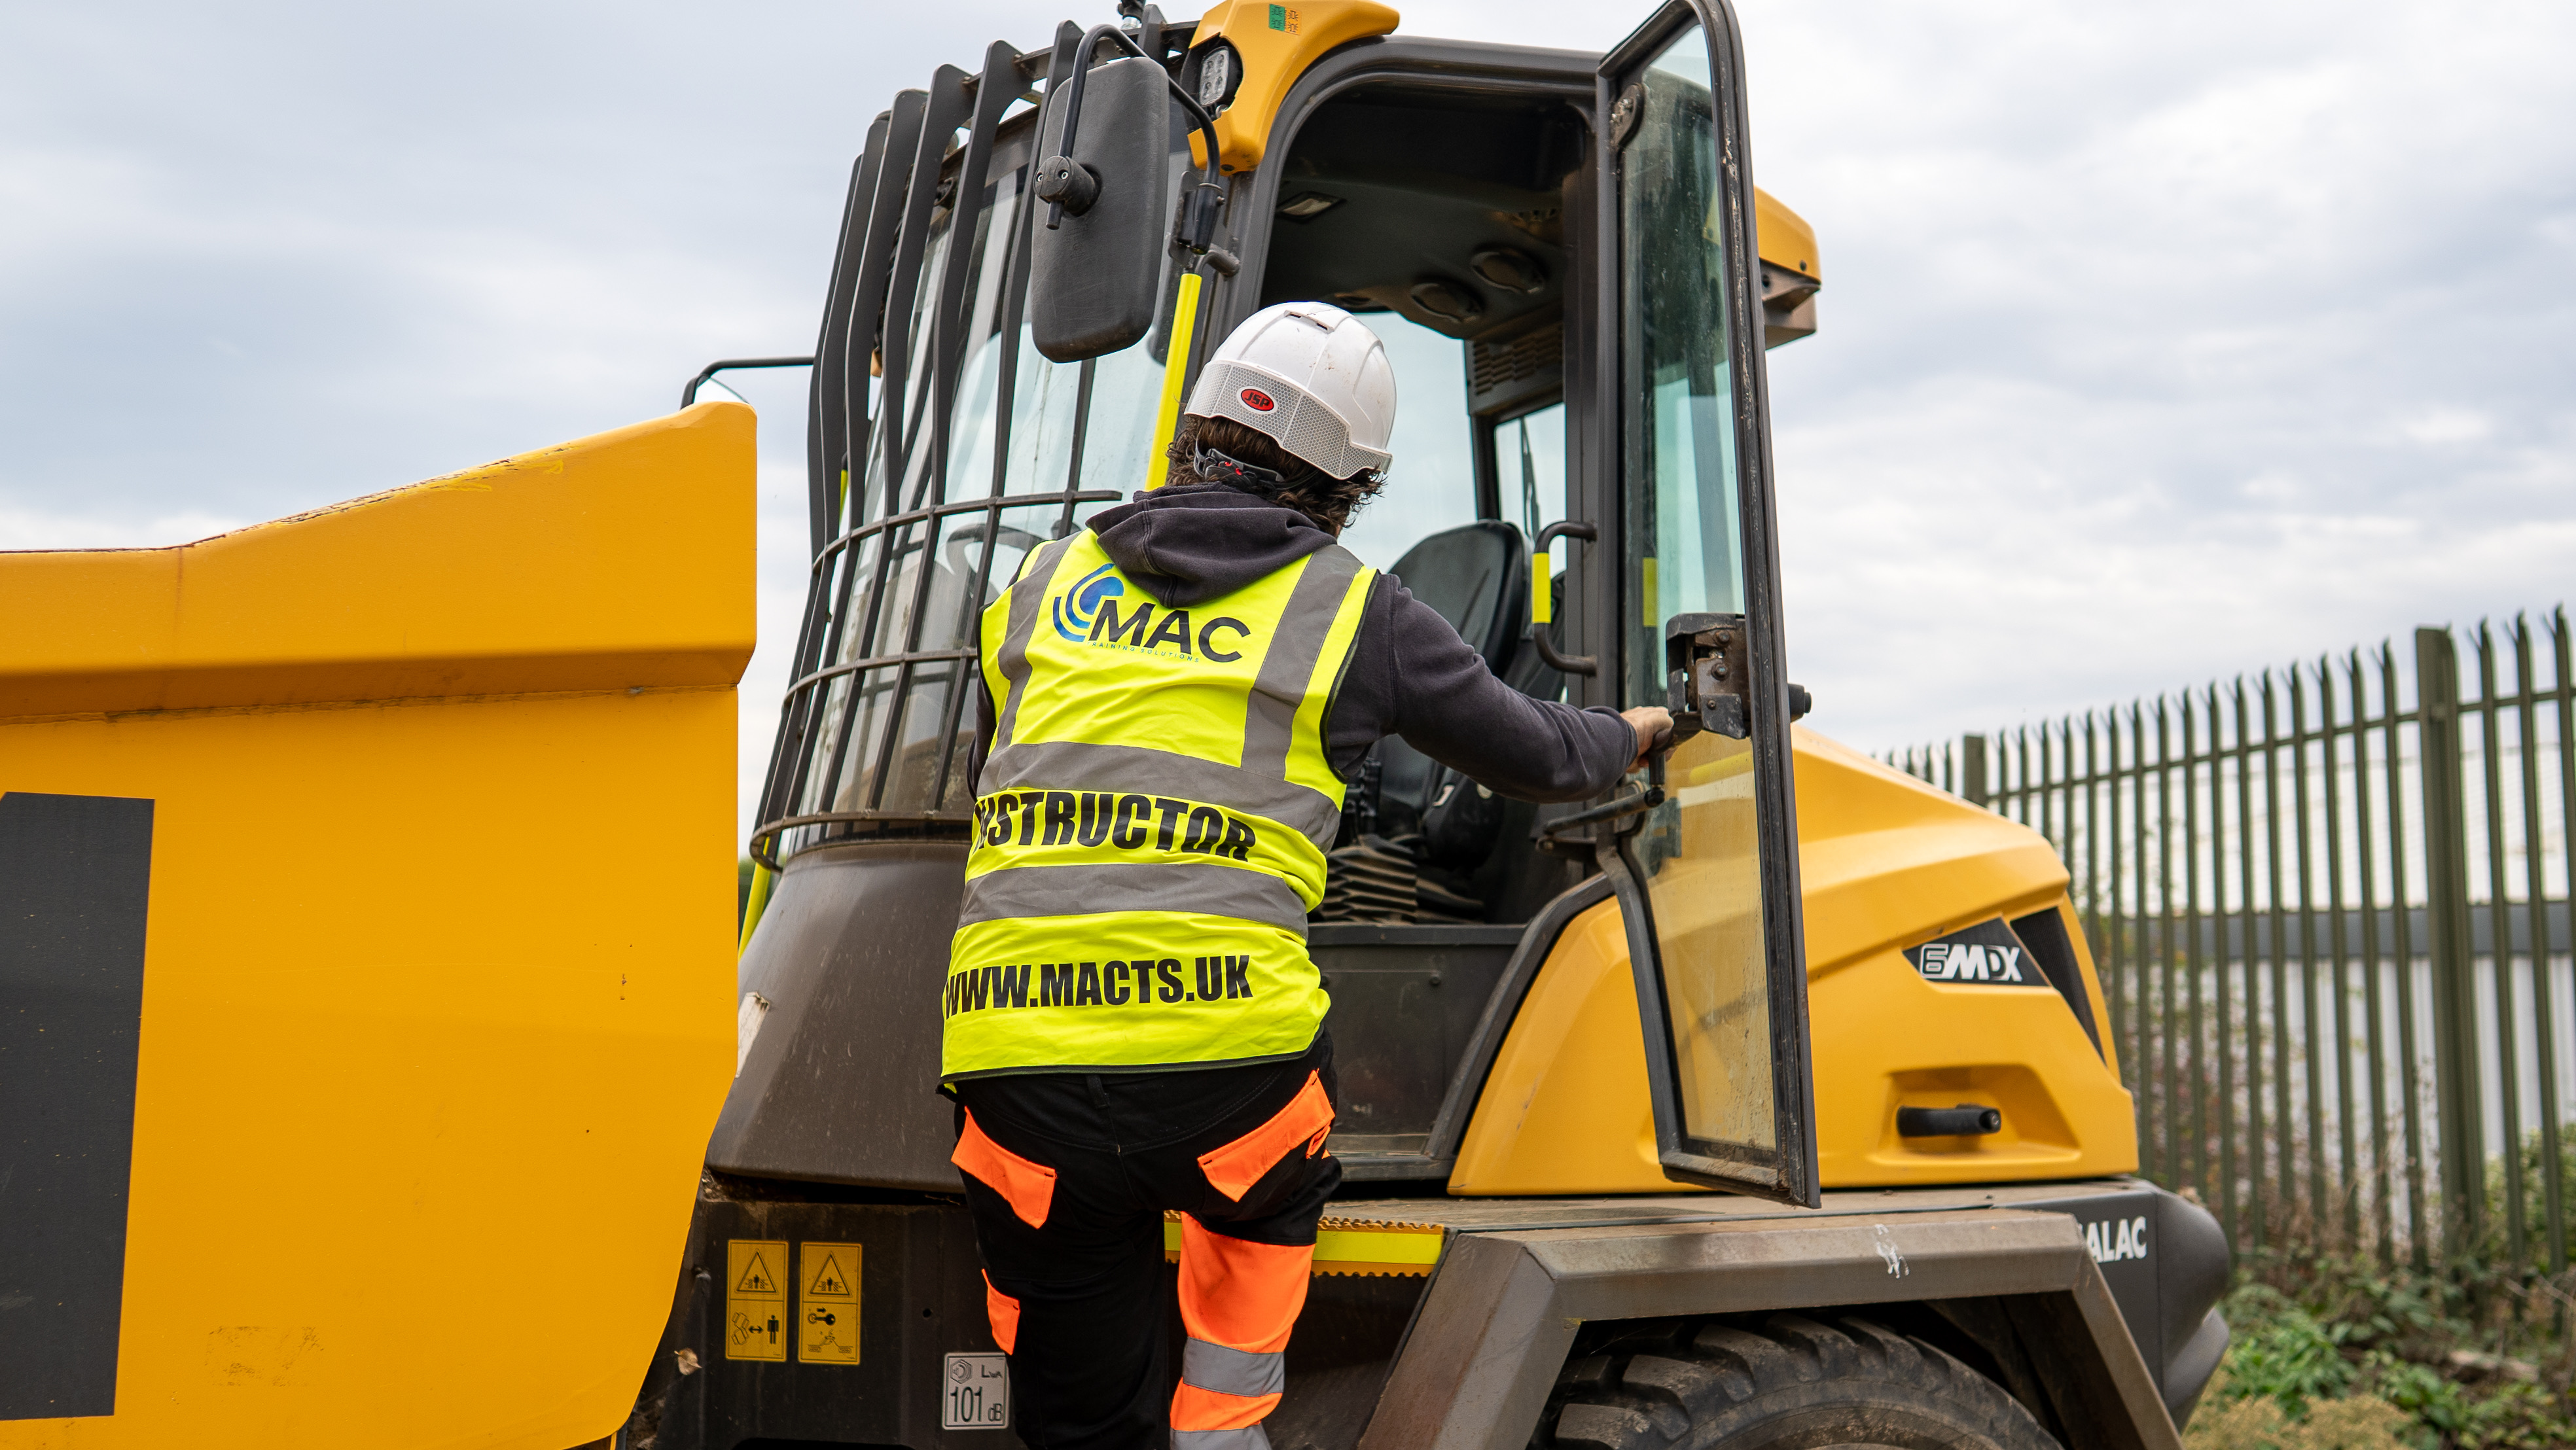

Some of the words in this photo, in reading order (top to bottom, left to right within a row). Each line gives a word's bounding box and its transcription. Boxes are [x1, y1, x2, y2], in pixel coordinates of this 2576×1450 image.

[1244, 392, 1270, 407] JSP
[1088, 599, 1251, 663] MAC
[1141, 648, 1199, 663] SOLUTIONS
[946, 955, 1253, 1019] WWW.MACTS.UK
[2079, 1216, 2147, 1263] ALAC
[950, 1387, 982, 1422] 101
[988, 1403, 1003, 1422] dB
